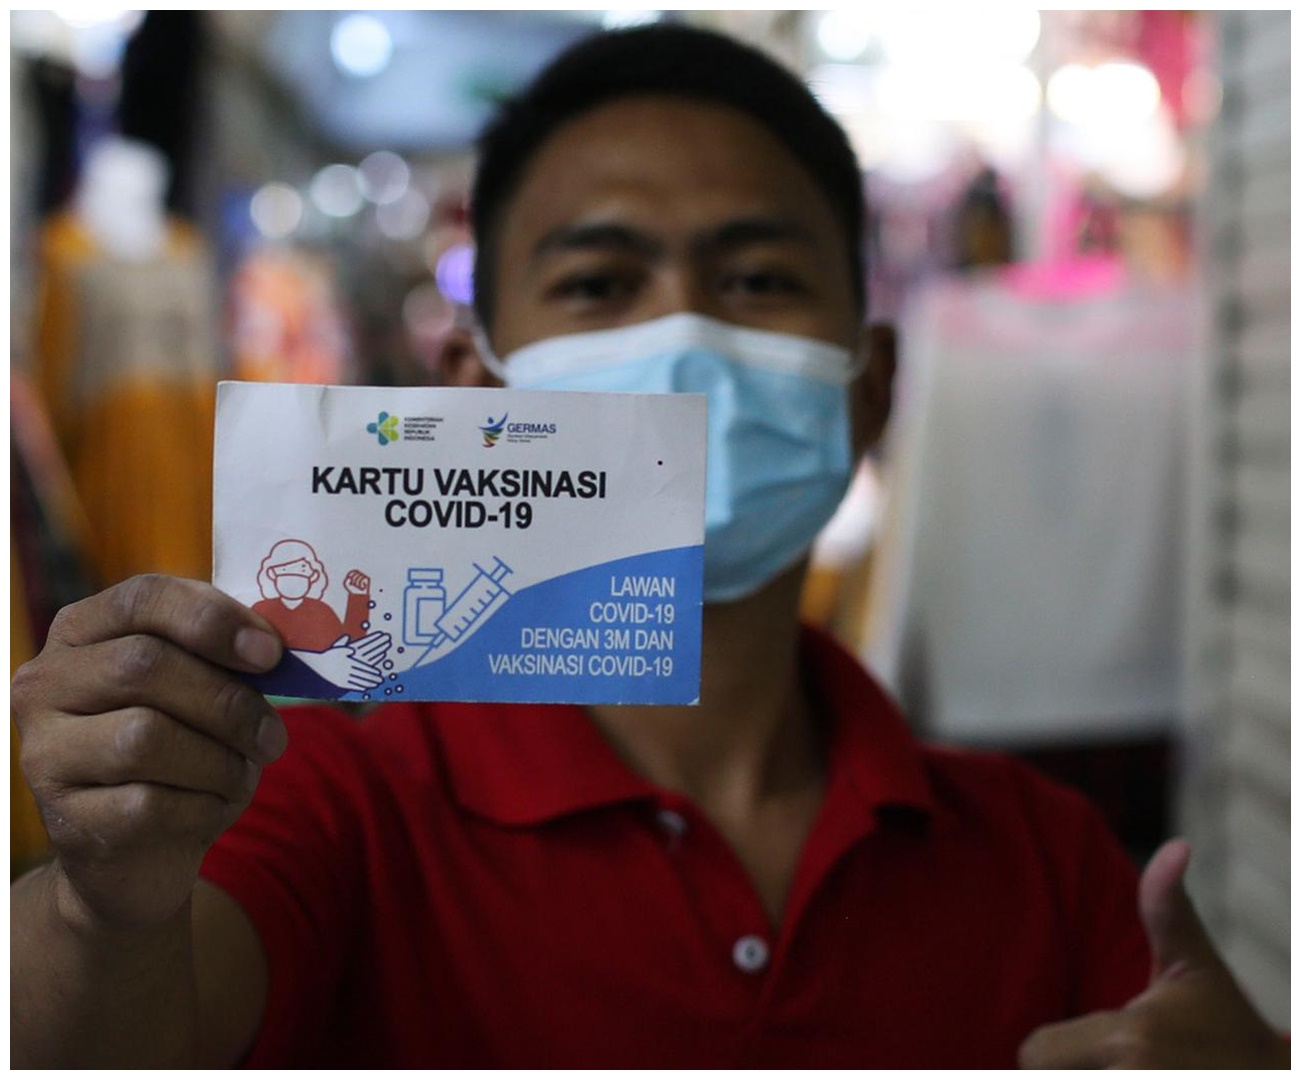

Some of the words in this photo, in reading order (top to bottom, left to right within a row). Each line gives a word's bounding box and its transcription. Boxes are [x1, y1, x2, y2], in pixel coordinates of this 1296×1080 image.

[507, 422, 557, 434] GERMAS
[312, 466, 424, 496] KARTU
[433, 469, 607, 499] VAKSINASI
[384, 499, 534, 530] COVID-19
[611, 576, 675, 598] LAWAN
[589, 602, 675, 624] COVID-19
[521, 628, 600, 650] DENGAN
[604, 628, 630, 650] 3M
[634, 630, 674, 651] DAN
[488, 653, 584, 676] VAKSINASI
[588, 655, 674, 677] COVID-19
